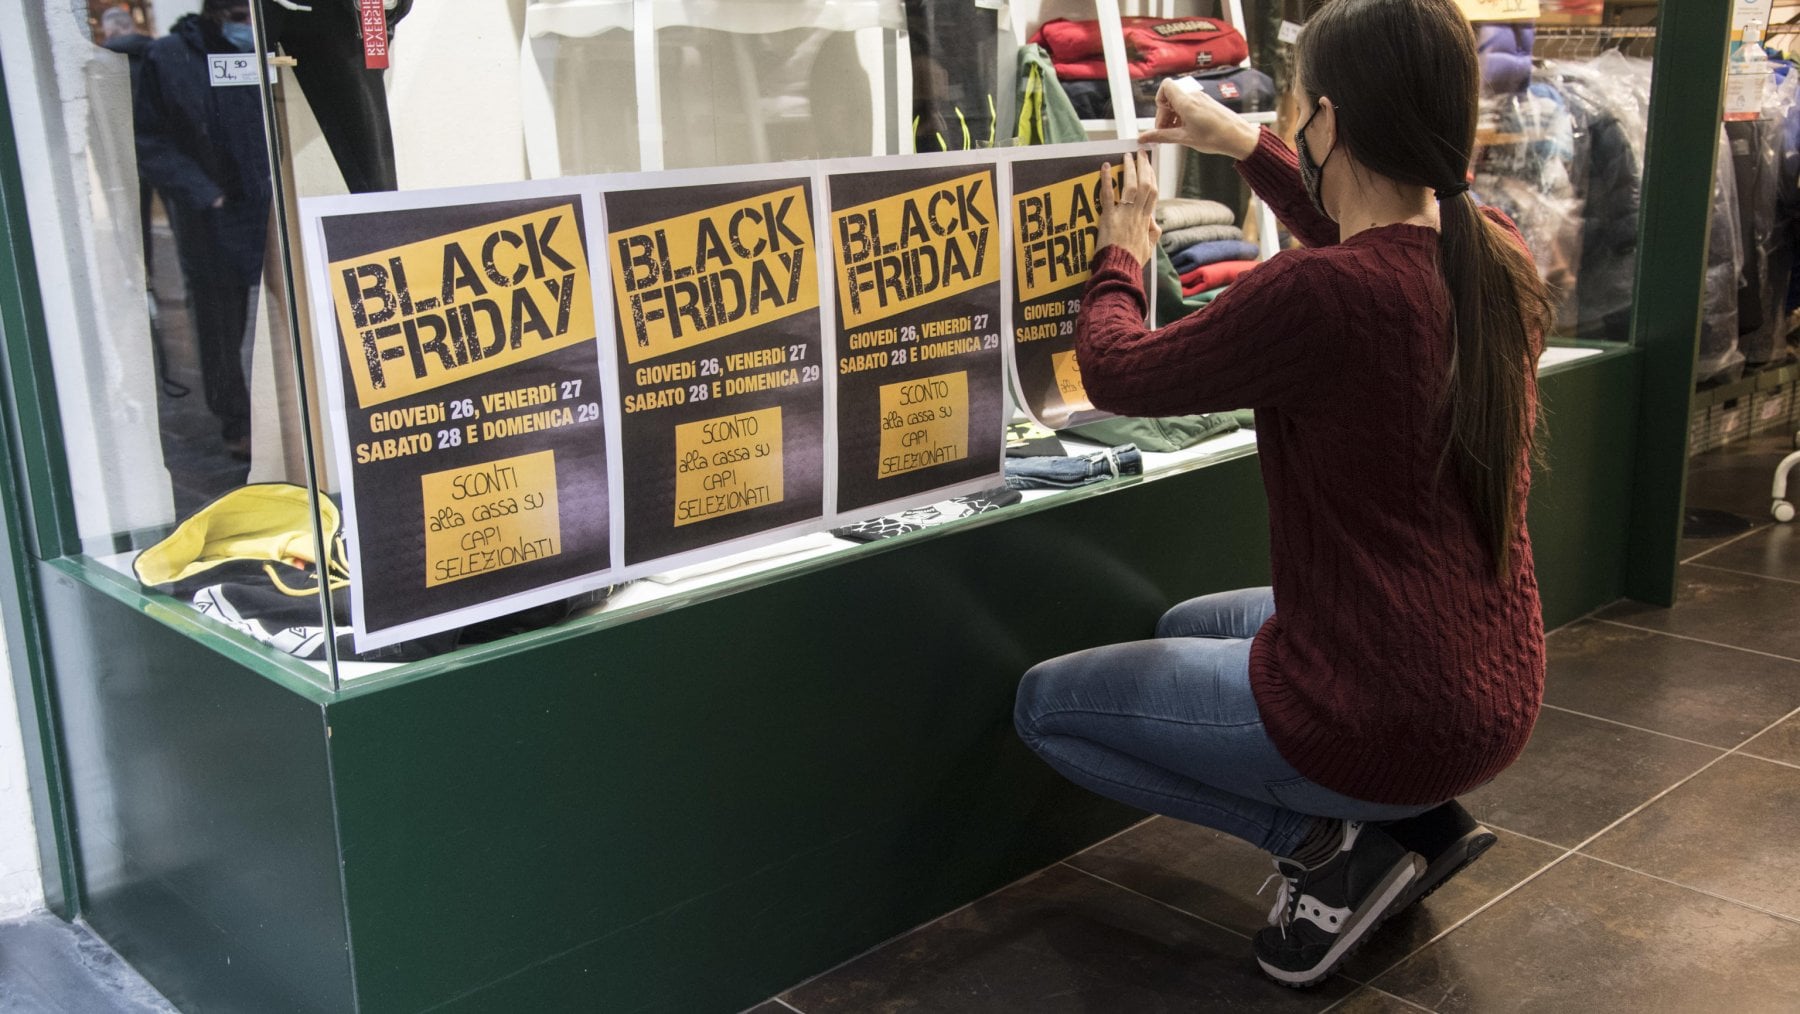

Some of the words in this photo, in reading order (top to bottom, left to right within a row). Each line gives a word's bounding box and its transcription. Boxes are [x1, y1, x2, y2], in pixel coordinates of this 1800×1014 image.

[838, 179, 990, 265] BLACK
[618, 195, 805, 292] BLACK
[342, 215, 576, 328] BLACK
[847, 227, 989, 315] FRIDAY
[630, 247, 804, 347] FRIDAY
[360, 272, 575, 390] FRIDAY
[900, 325, 920, 343] 26,
[974, 314, 989, 330] 27
[1016, 323, 1057, 343] SABATO
[1059, 320, 1073, 336] 28
[700, 358, 724, 377] 26,
[789, 344, 807, 361] 27
[840, 352, 888, 374] SABATO
[891, 350, 907, 366] 28
[910, 347, 918, 362] E
[921, 336, 981, 361] DOMENICA
[983, 333, 999, 350] 29
[450, 398, 480, 420] 26,
[561, 379, 582, 400] 27
[624, 387, 685, 414] SABATO
[689, 384, 708, 403] 28
[712, 381, 721, 399] E
[725, 368, 799, 396] DOMENICA
[802, 364, 820, 383] 29
[356, 432, 432, 464] SABATO
[437, 428, 462, 449] 28
[466, 425, 478, 444] E
[483, 407, 574, 441] DOMENICA
[577, 402, 600, 423] 29
[701, 416, 758, 445] SCONTO
[713, 447, 750, 466] cassa
[451, 463, 518, 500] SCONTI
[678, 482, 770, 520] SELEZIONATI
[703, 470, 737, 491] CAPI
[430, 506, 465, 532] alla
[472, 498, 518, 522] cassa
[435, 536, 554, 581] SELEZIONATI
[461, 526, 502, 551] CAPI
